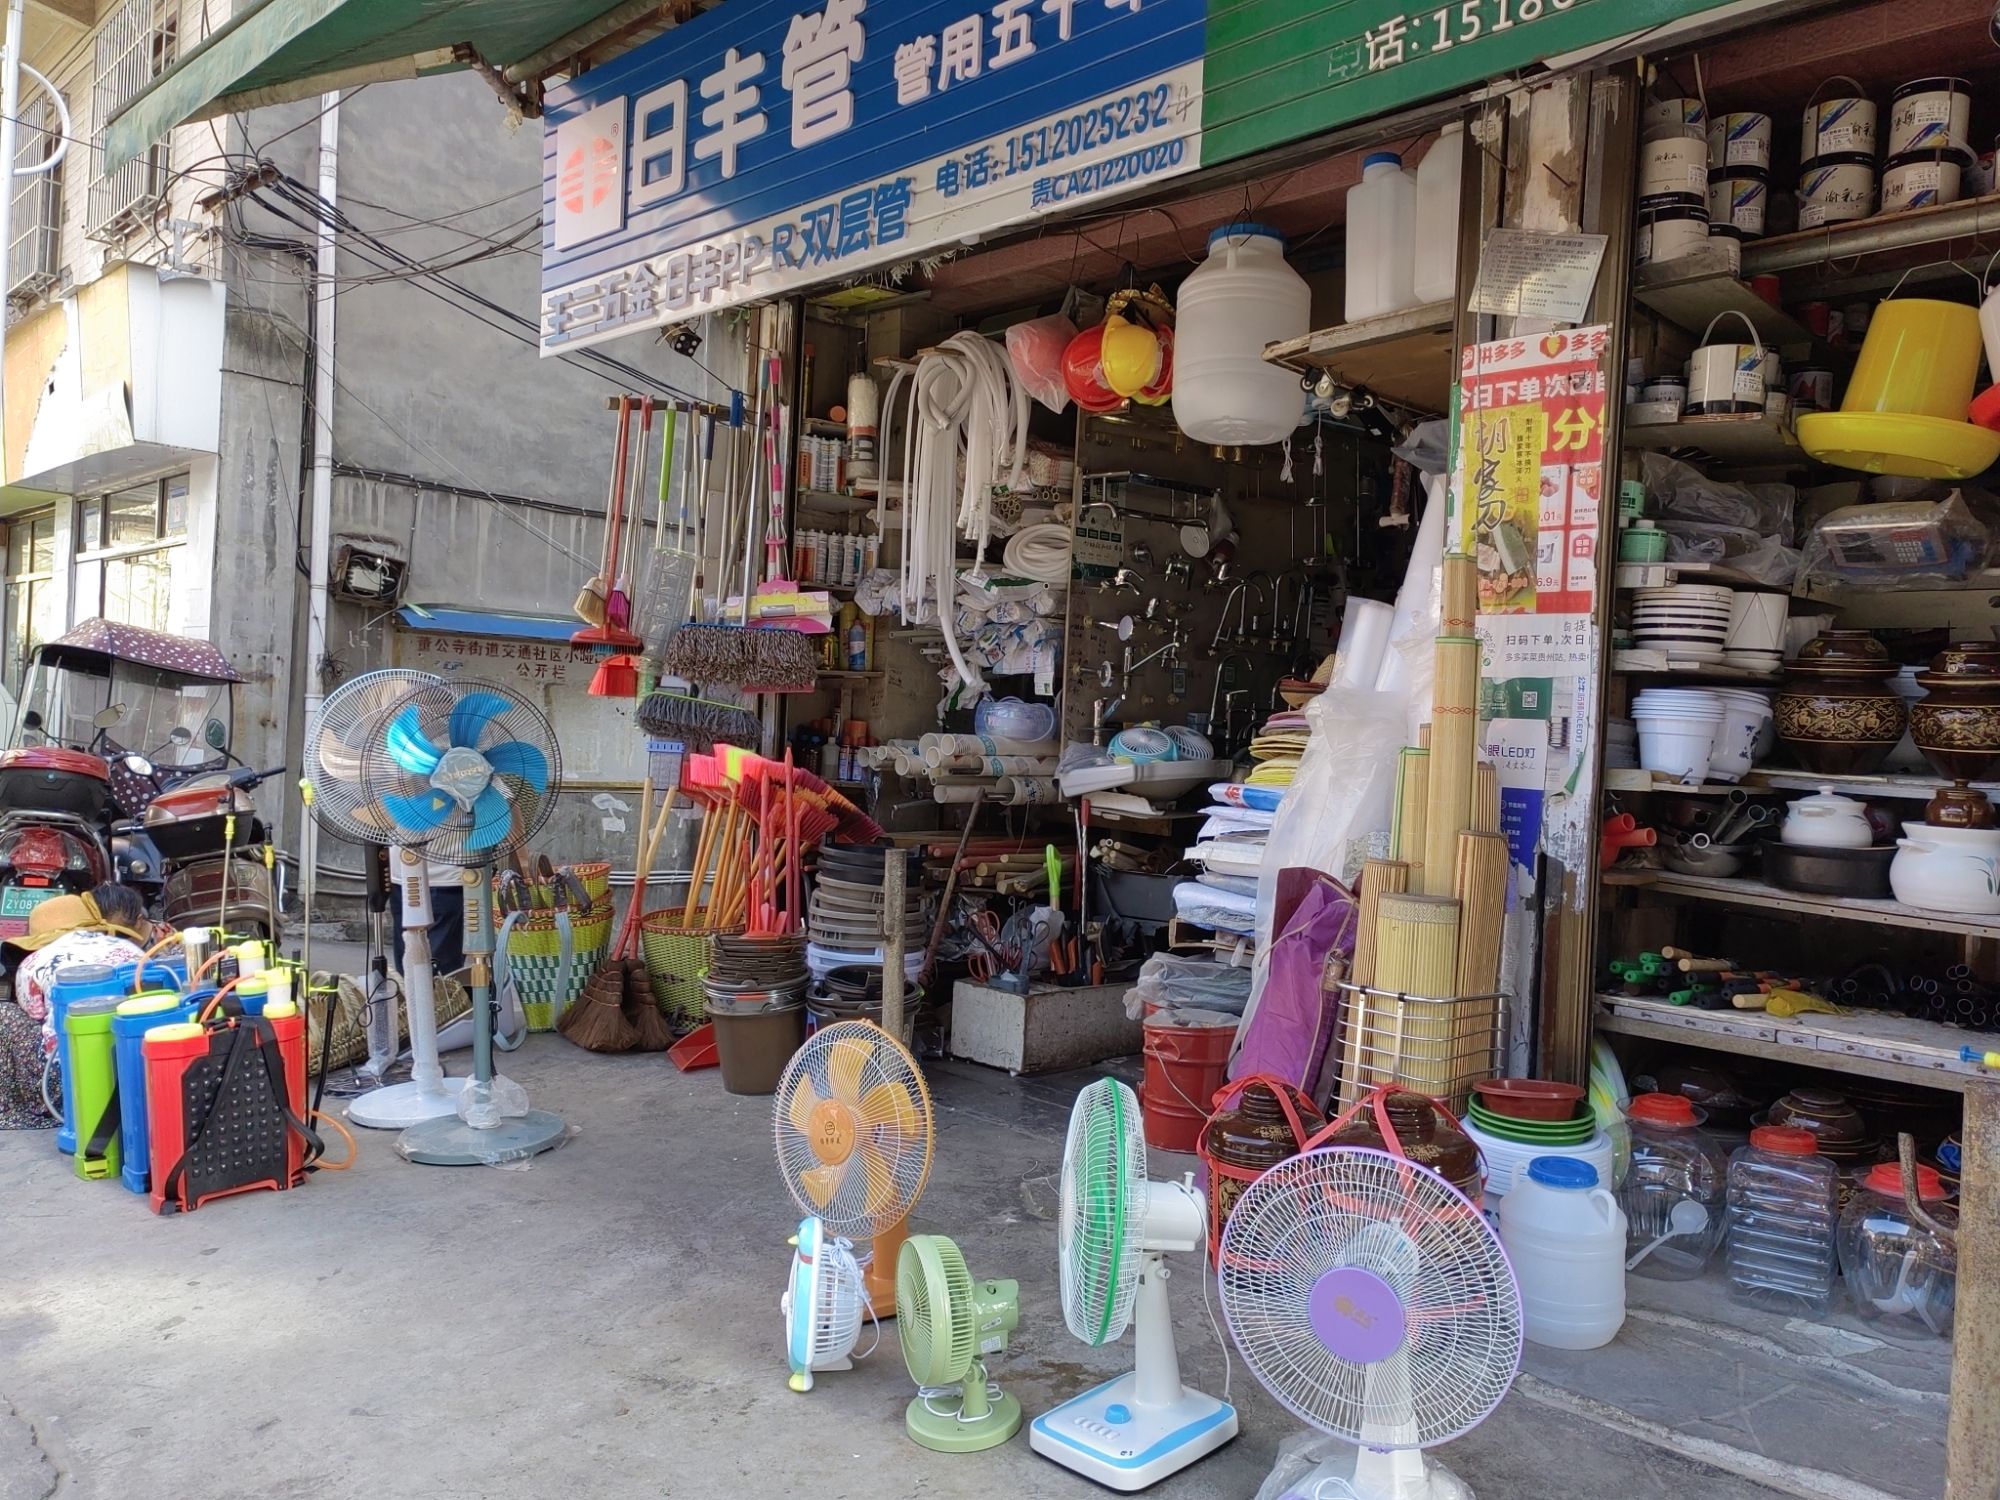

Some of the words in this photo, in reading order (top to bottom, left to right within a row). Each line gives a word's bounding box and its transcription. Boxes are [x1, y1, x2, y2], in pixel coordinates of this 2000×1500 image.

[631, 0, 868, 207] 日丰管
[1506, 634, 1591, 646] 扫码下单,次日
[516, 662, 566, 680] 公开栏
